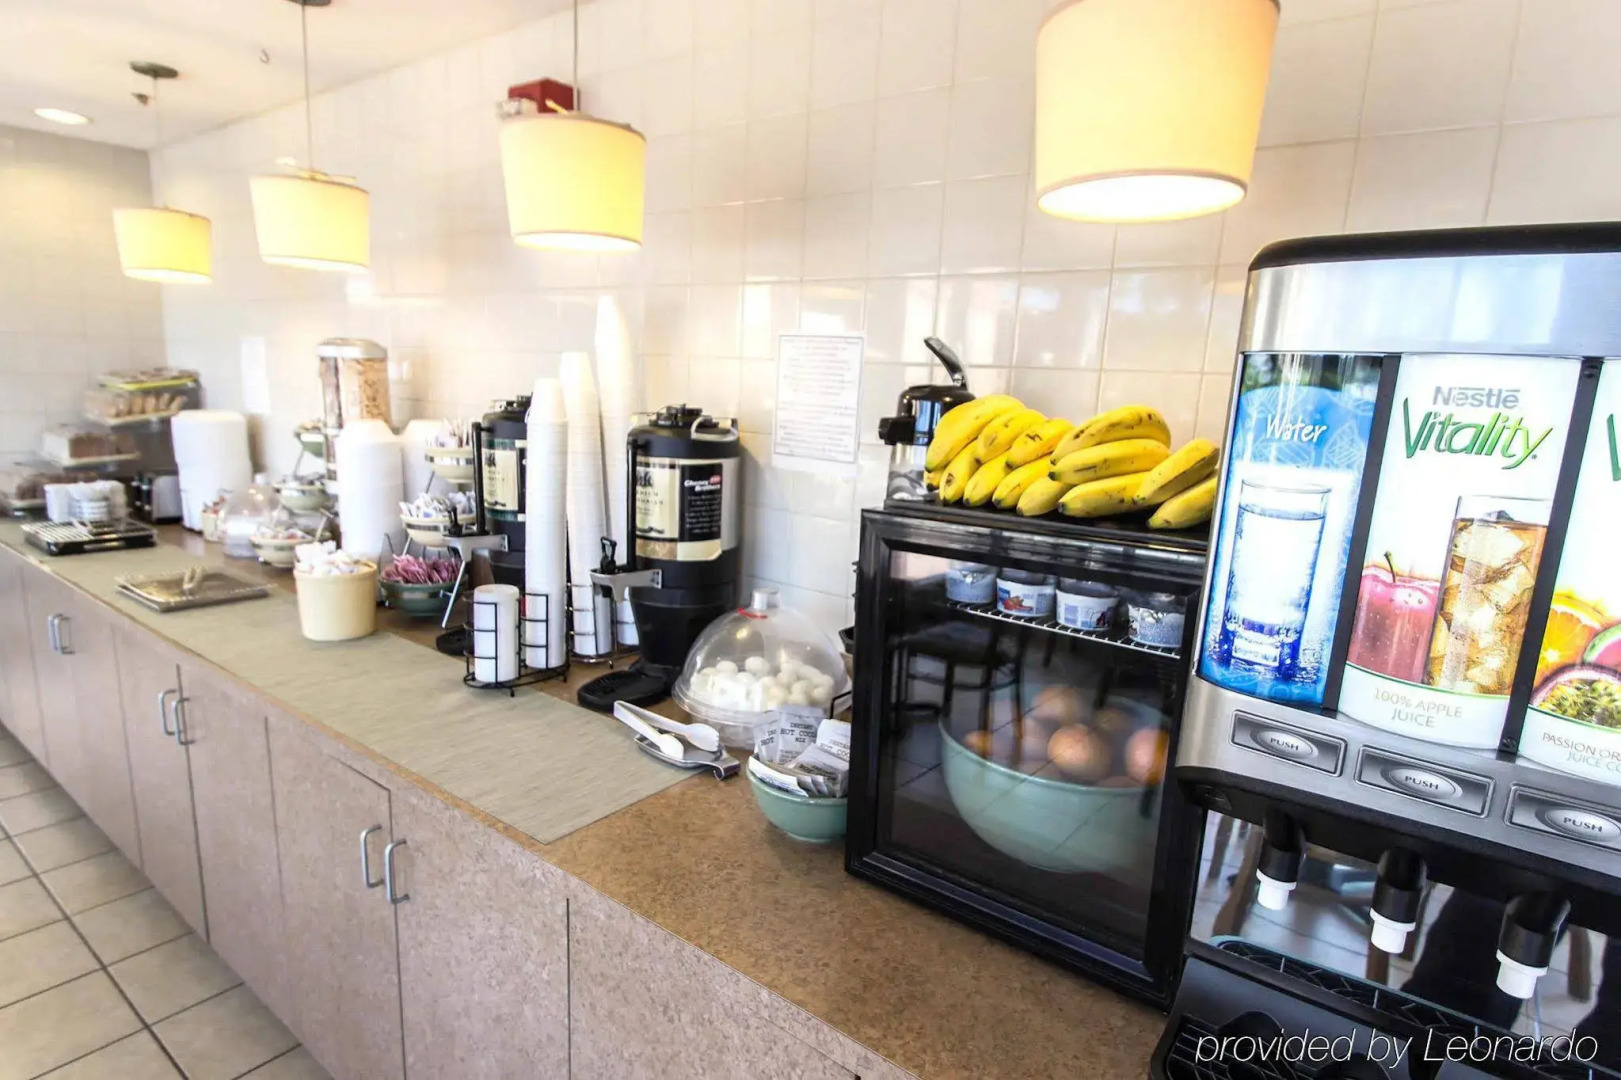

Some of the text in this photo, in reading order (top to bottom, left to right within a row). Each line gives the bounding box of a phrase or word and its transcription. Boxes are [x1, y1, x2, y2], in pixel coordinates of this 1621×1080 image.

[1266, 413, 1328, 443] Water
[1403, 397, 1553, 470] Vitality
[1374, 687, 1463, 718] 100% APPLE
[1391, 708, 1435, 728] JUICE
[1270, 737, 1299, 751] PUSH
[1542, 732, 1597, 756] PASSION
[1567, 751, 1602, 768] JUICE
[1405, 775, 1439, 790] PUSH
[1563, 816, 1603, 832] PUSH
